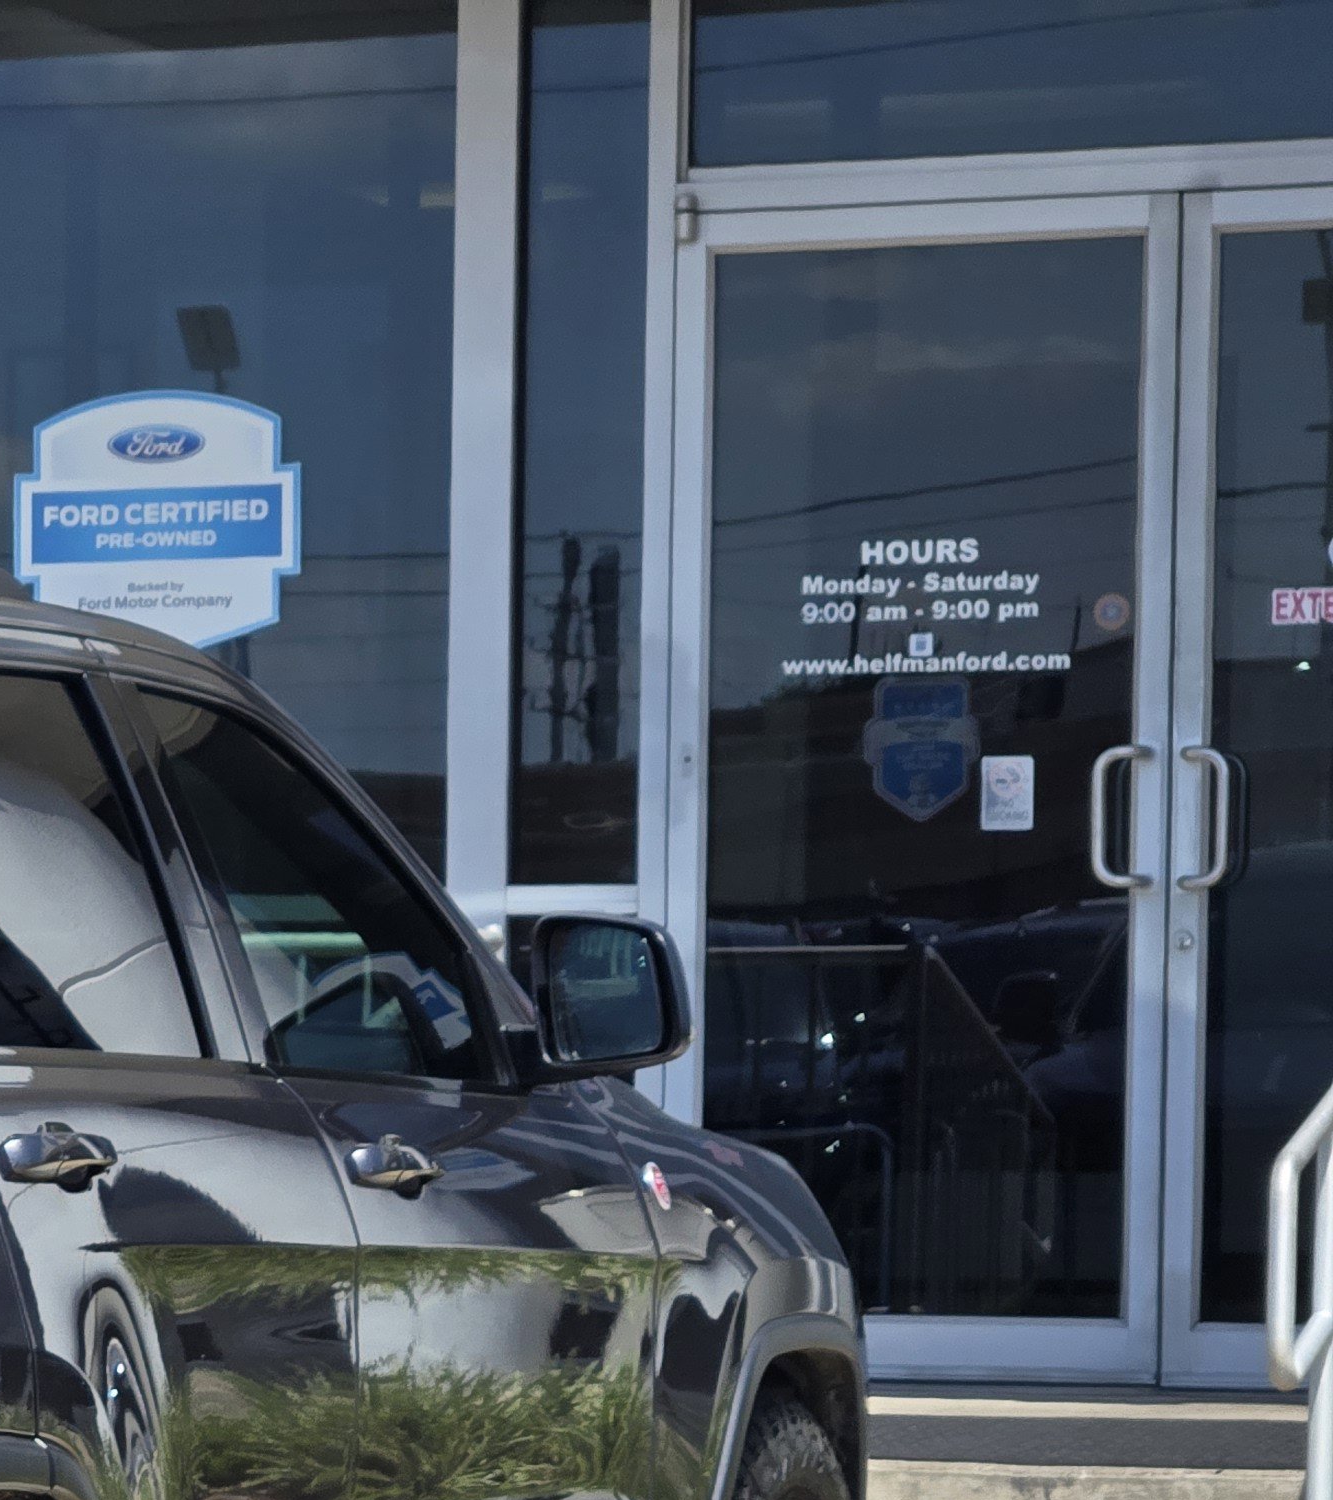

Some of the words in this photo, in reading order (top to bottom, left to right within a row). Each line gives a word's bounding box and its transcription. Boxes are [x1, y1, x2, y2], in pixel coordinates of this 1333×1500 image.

[126, 431, 186, 456] Ford
[44, 504, 119, 528] FORD
[124, 499, 269, 526] CERTIFIED
[96, 530, 217, 549] PRE-OWNED
[861, 538, 980, 566] HOURS
[801, 574, 901, 598] Monday
[924, 569, 1040, 596] Saturday
[78, 597, 112, 611] Ford
[114, 595, 158, 609] Motor
[161, 593, 233, 610] Company
[801, 602, 856, 624] 9:00
[866, 604, 907, 621] am
[932, 599, 989, 620] 9:00
[998, 601, 1040, 624] pm
[782, 651, 1071, 676] www.helfmanford.com
